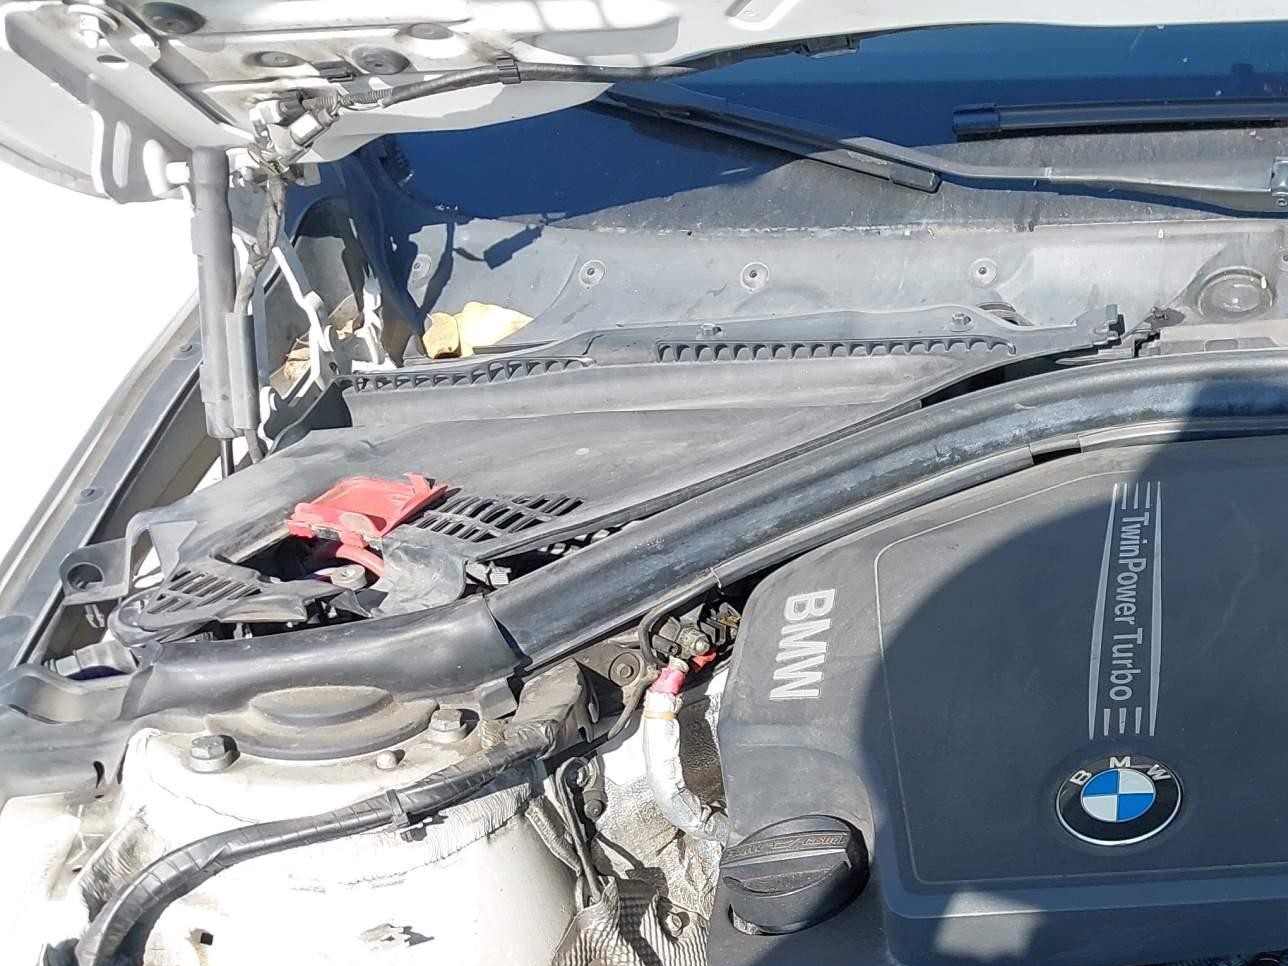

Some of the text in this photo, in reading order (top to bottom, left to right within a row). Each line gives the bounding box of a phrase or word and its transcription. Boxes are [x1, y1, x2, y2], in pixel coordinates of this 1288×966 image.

[769, 589, 835, 700] BMW
[1109, 512, 1150, 701] TwinPower Turbo
[1069, 756, 1172, 786] BMW
